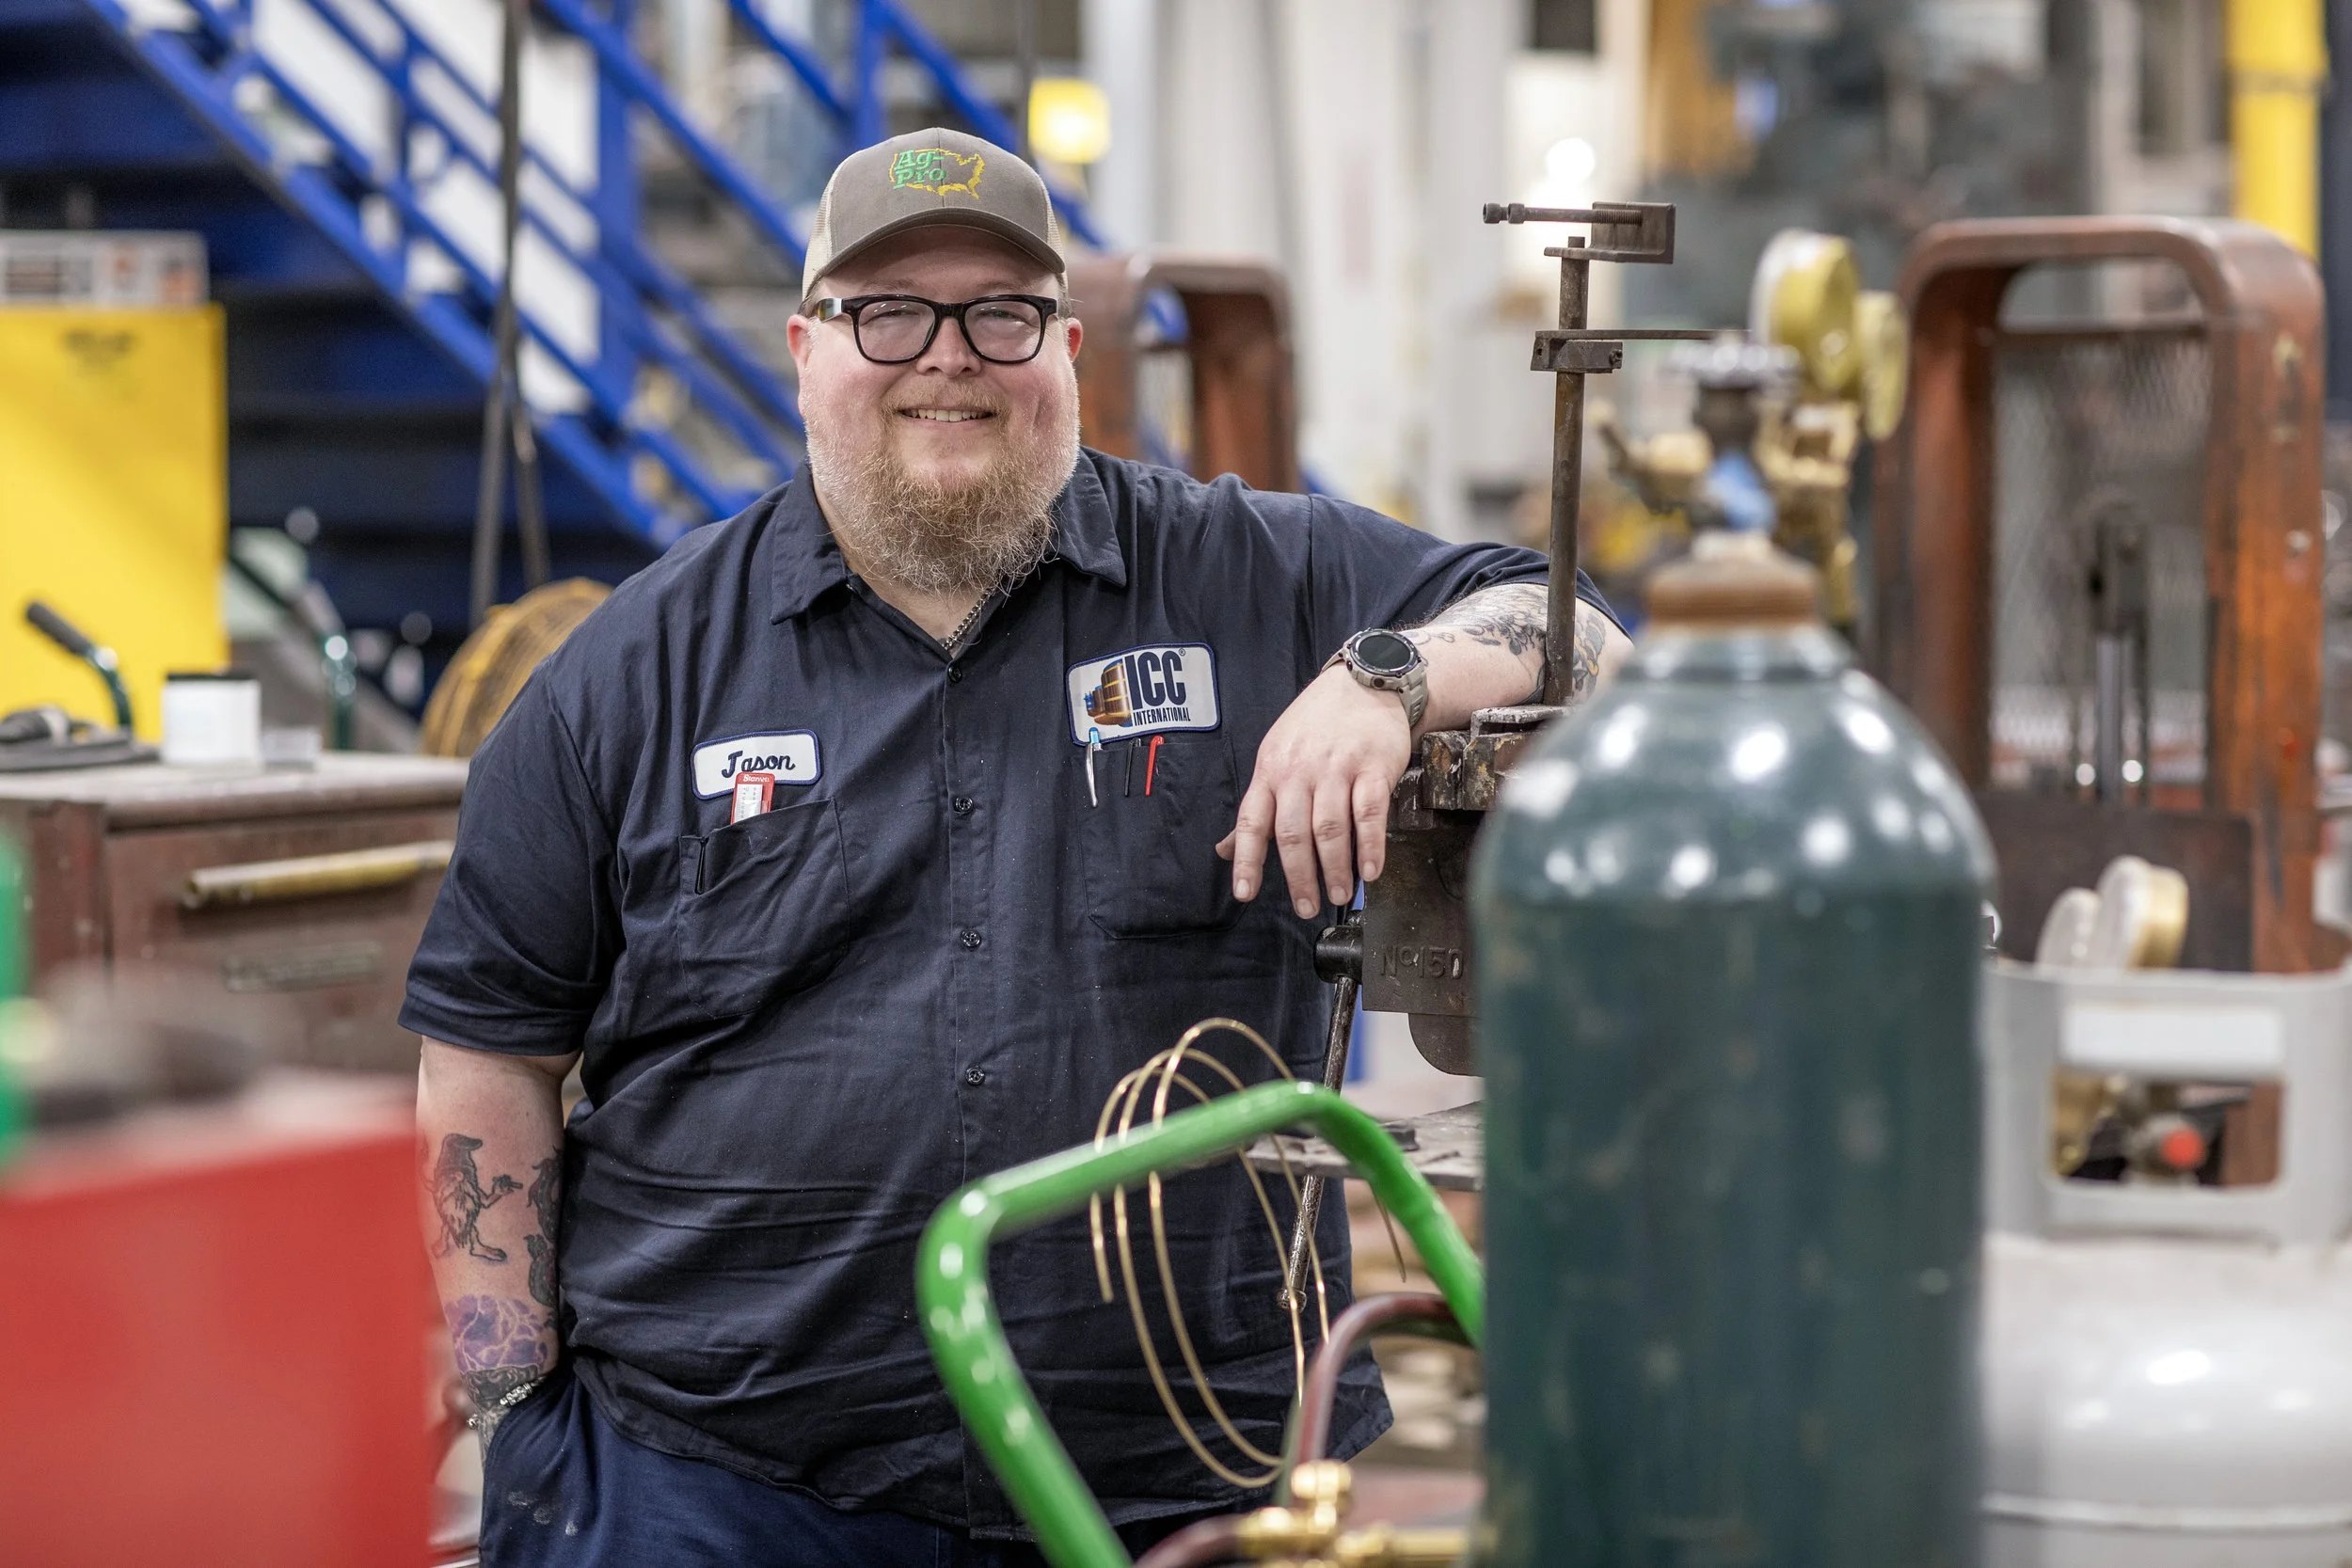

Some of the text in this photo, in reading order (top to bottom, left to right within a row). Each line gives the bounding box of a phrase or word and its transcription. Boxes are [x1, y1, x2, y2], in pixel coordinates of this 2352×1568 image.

[894, 150, 944, 170] Ag-
[894, 167, 946, 189] Pro
[1124, 650, 1186, 710] ICC
[1133, 707, 1191, 726] INTERNATIONAL
[722, 751, 795, 778] Jason
[1419, 946, 1463, 978] 150
